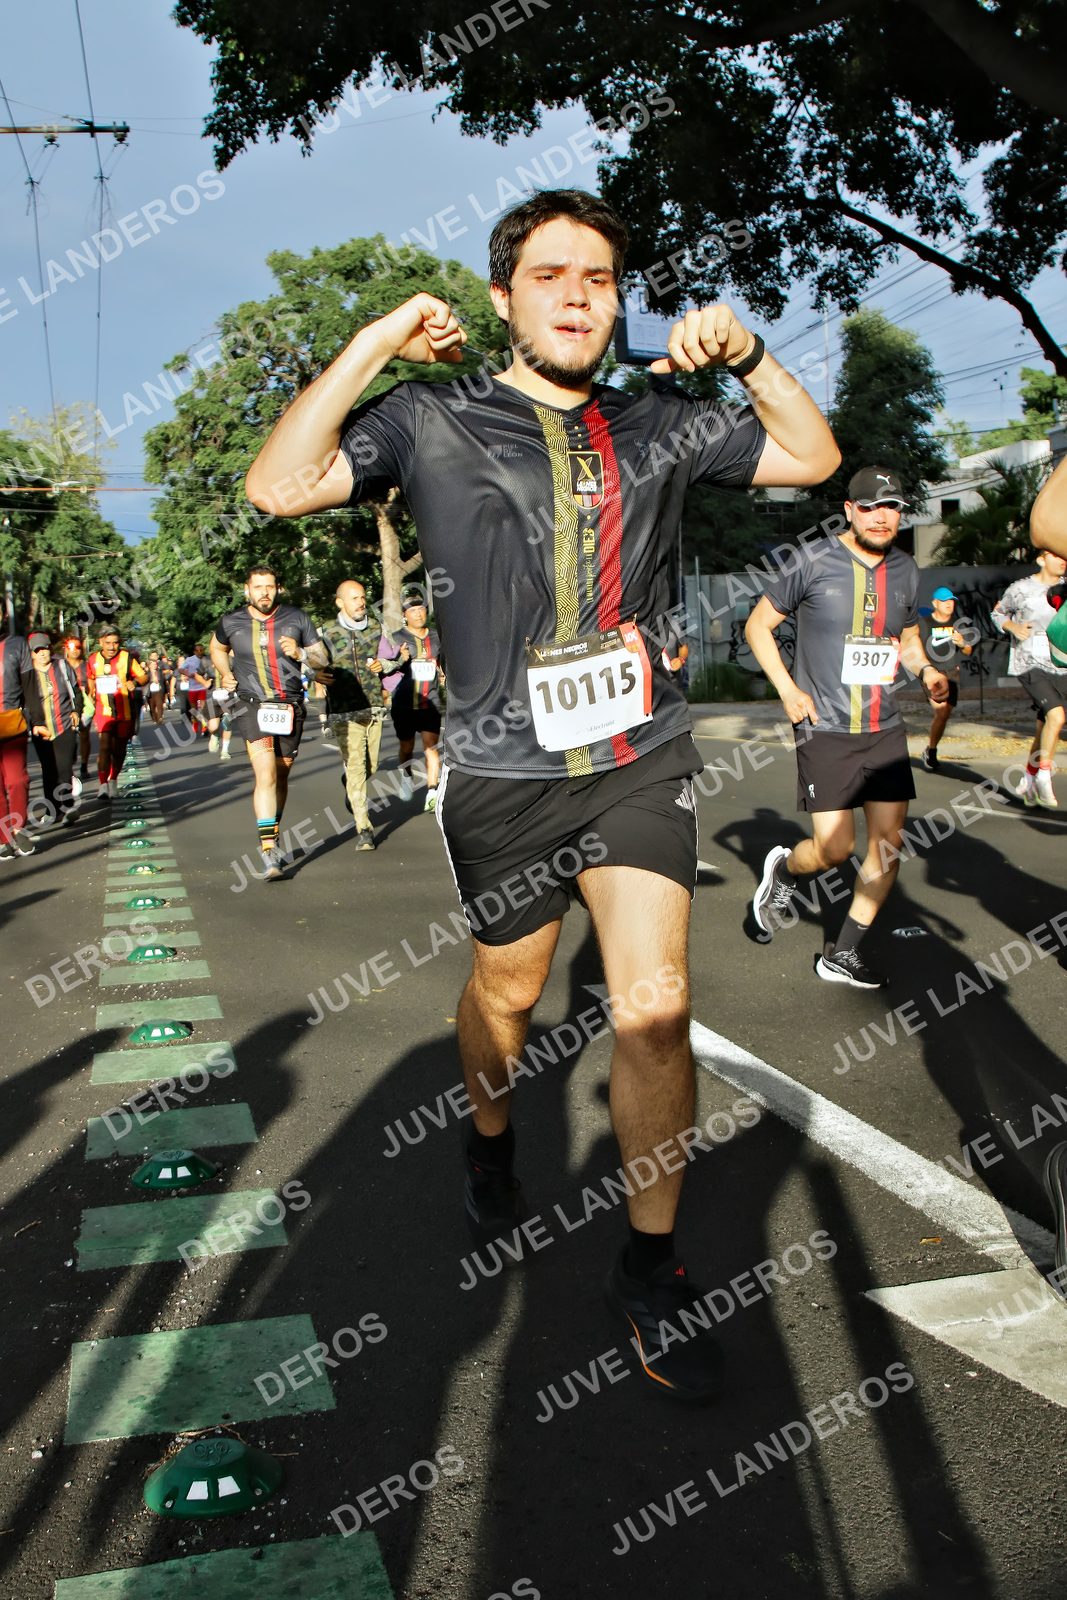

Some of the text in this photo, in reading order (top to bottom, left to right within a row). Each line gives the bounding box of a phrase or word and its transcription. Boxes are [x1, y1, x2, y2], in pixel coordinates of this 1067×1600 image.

[852, 651, 890, 667] 9307
[535, 660, 637, 714] 10115
[262, 713, 286, 723] 8538
